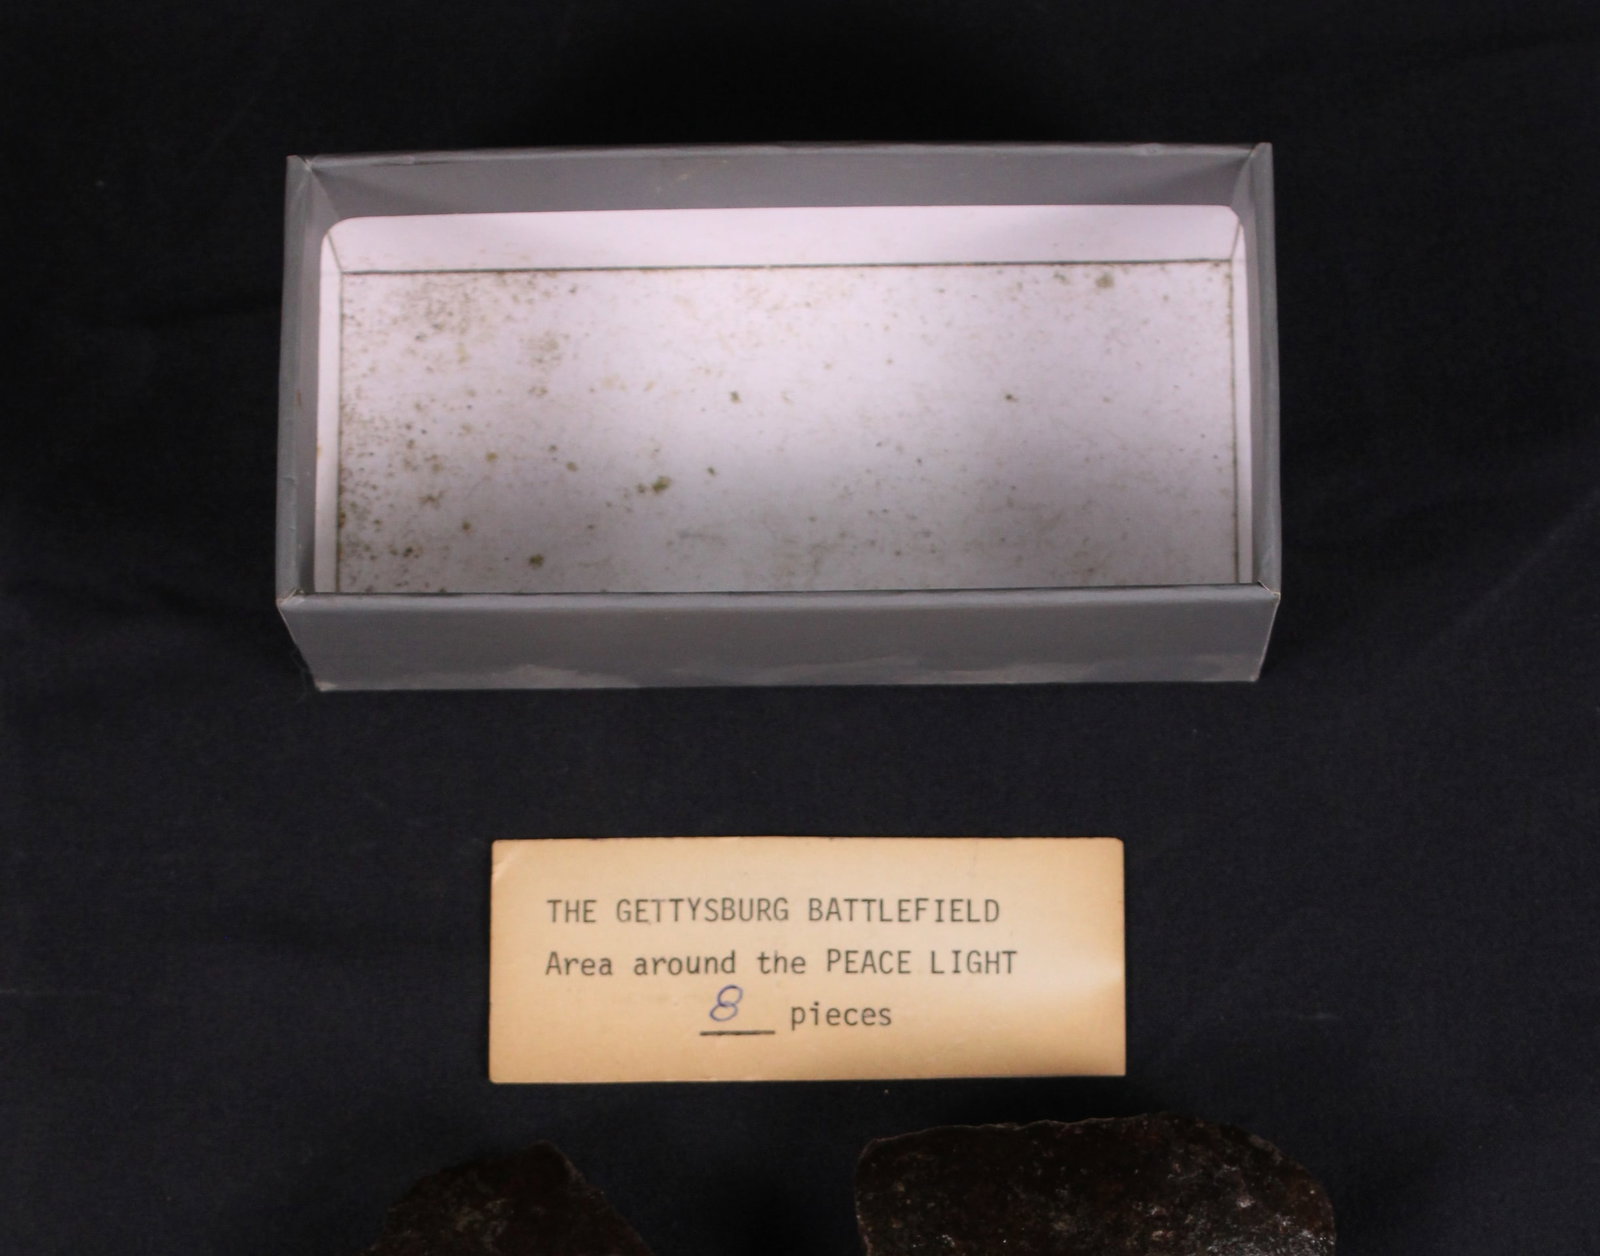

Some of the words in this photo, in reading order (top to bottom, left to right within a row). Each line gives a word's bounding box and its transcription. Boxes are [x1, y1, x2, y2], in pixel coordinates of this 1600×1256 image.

[547, 898, 597, 924] THE
[615, 896, 790, 924] GETTYSBURG
[808, 896, 1001, 924] BATTLEFIELD
[545, 951, 614, 977] Area
[633, 949, 737, 977] around
[756, 951, 808, 976] the
[825, 948, 912, 975] PEACE
[930, 949, 1019, 975] LIGHT
[708, 984, 744, 1022] 8
[790, 1000, 893, 1032] pieces
